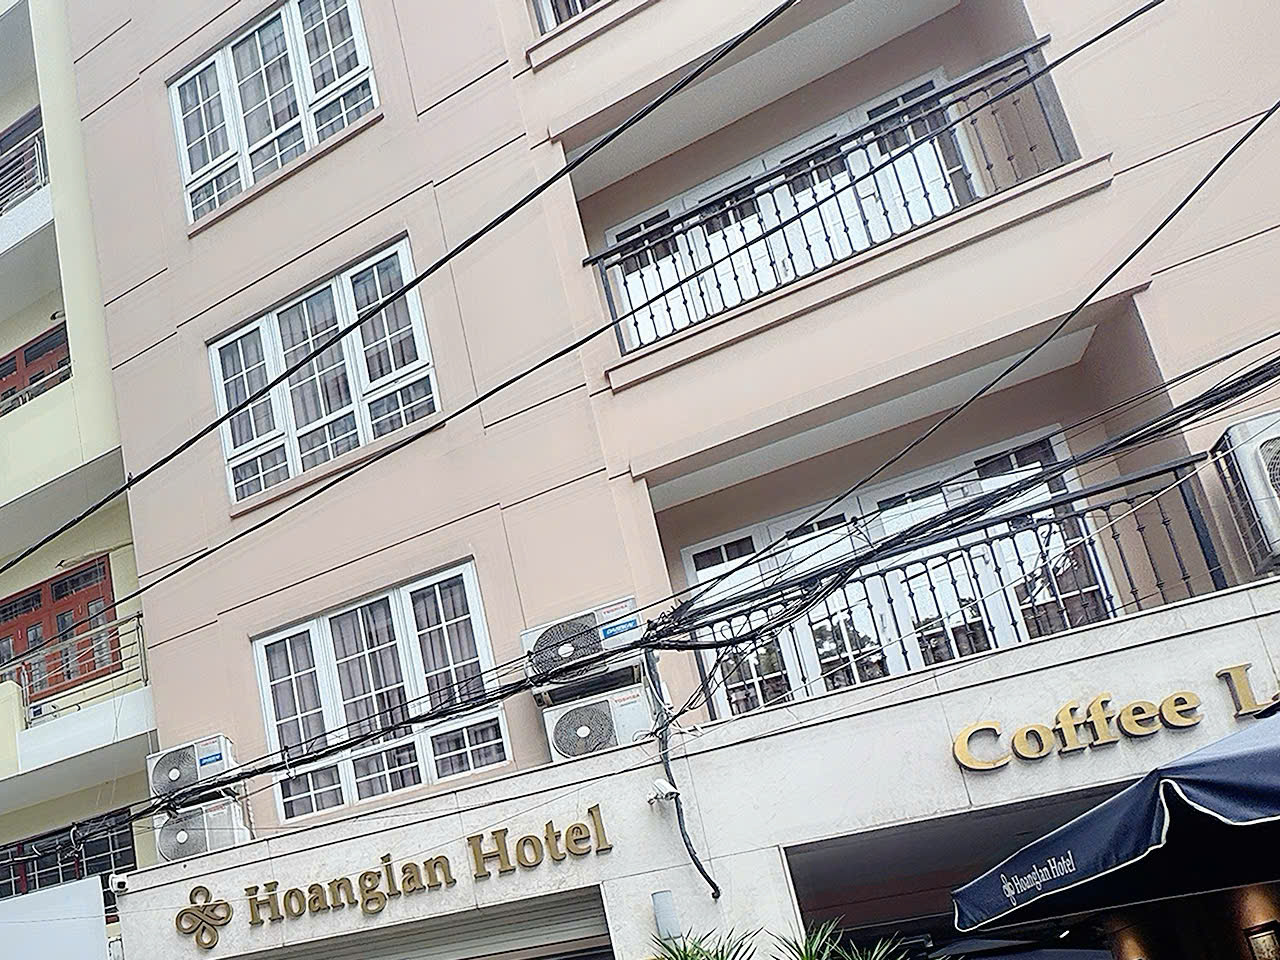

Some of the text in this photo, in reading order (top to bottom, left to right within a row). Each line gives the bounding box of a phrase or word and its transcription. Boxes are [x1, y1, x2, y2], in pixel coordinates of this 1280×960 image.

[953, 690, 1205, 771] Coffee
[467, 803, 614, 880] Hotel
[1047, 850, 1077, 879] Hotel
